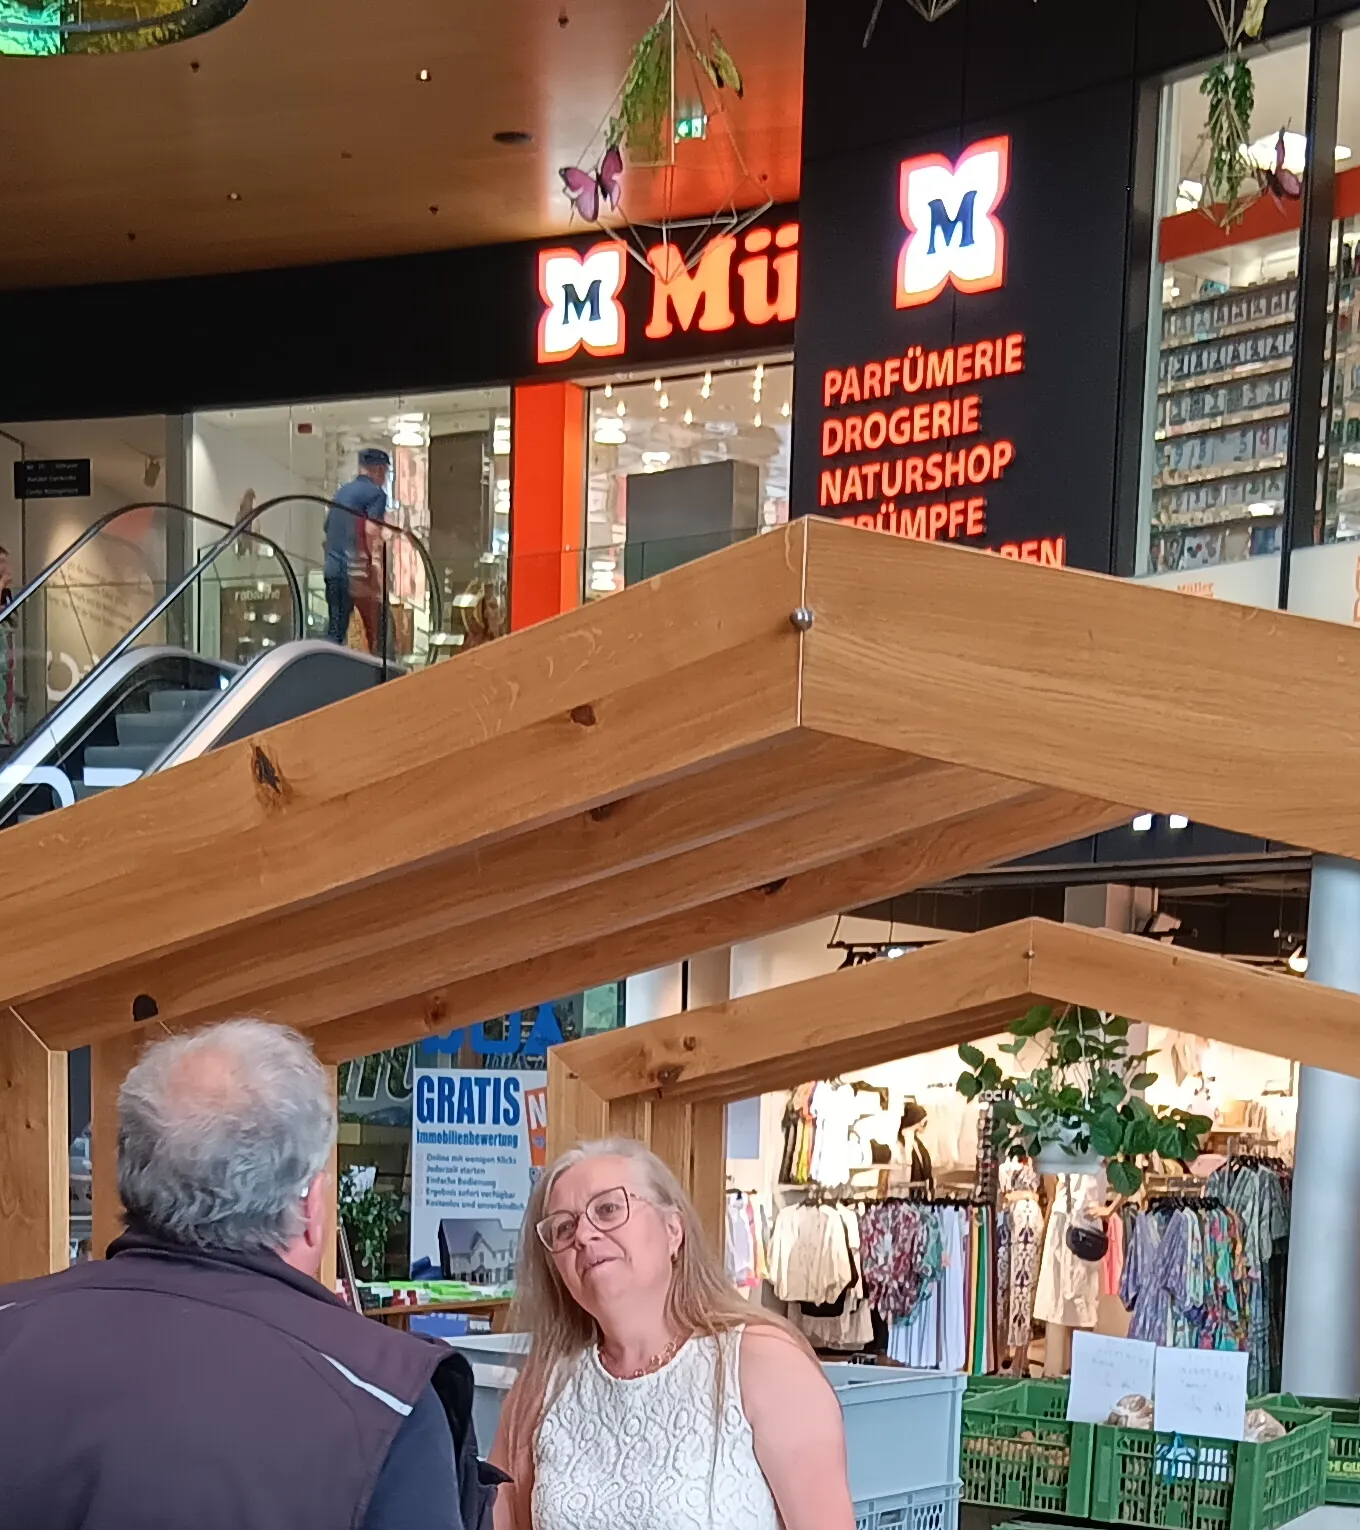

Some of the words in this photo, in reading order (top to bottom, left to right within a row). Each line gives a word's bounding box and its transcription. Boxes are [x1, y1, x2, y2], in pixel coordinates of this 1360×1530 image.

[645, 222, 800, 339] Mü
[823, 332, 1026, 408] PARFÜMERIE
[821, 393, 983, 457] DROGERIE
[818, 439, 1016, 507] NATURSHOP
[416, 1075, 521, 1127] GRATIS
[416, 1128, 519, 1149] Immobilienbewertung
